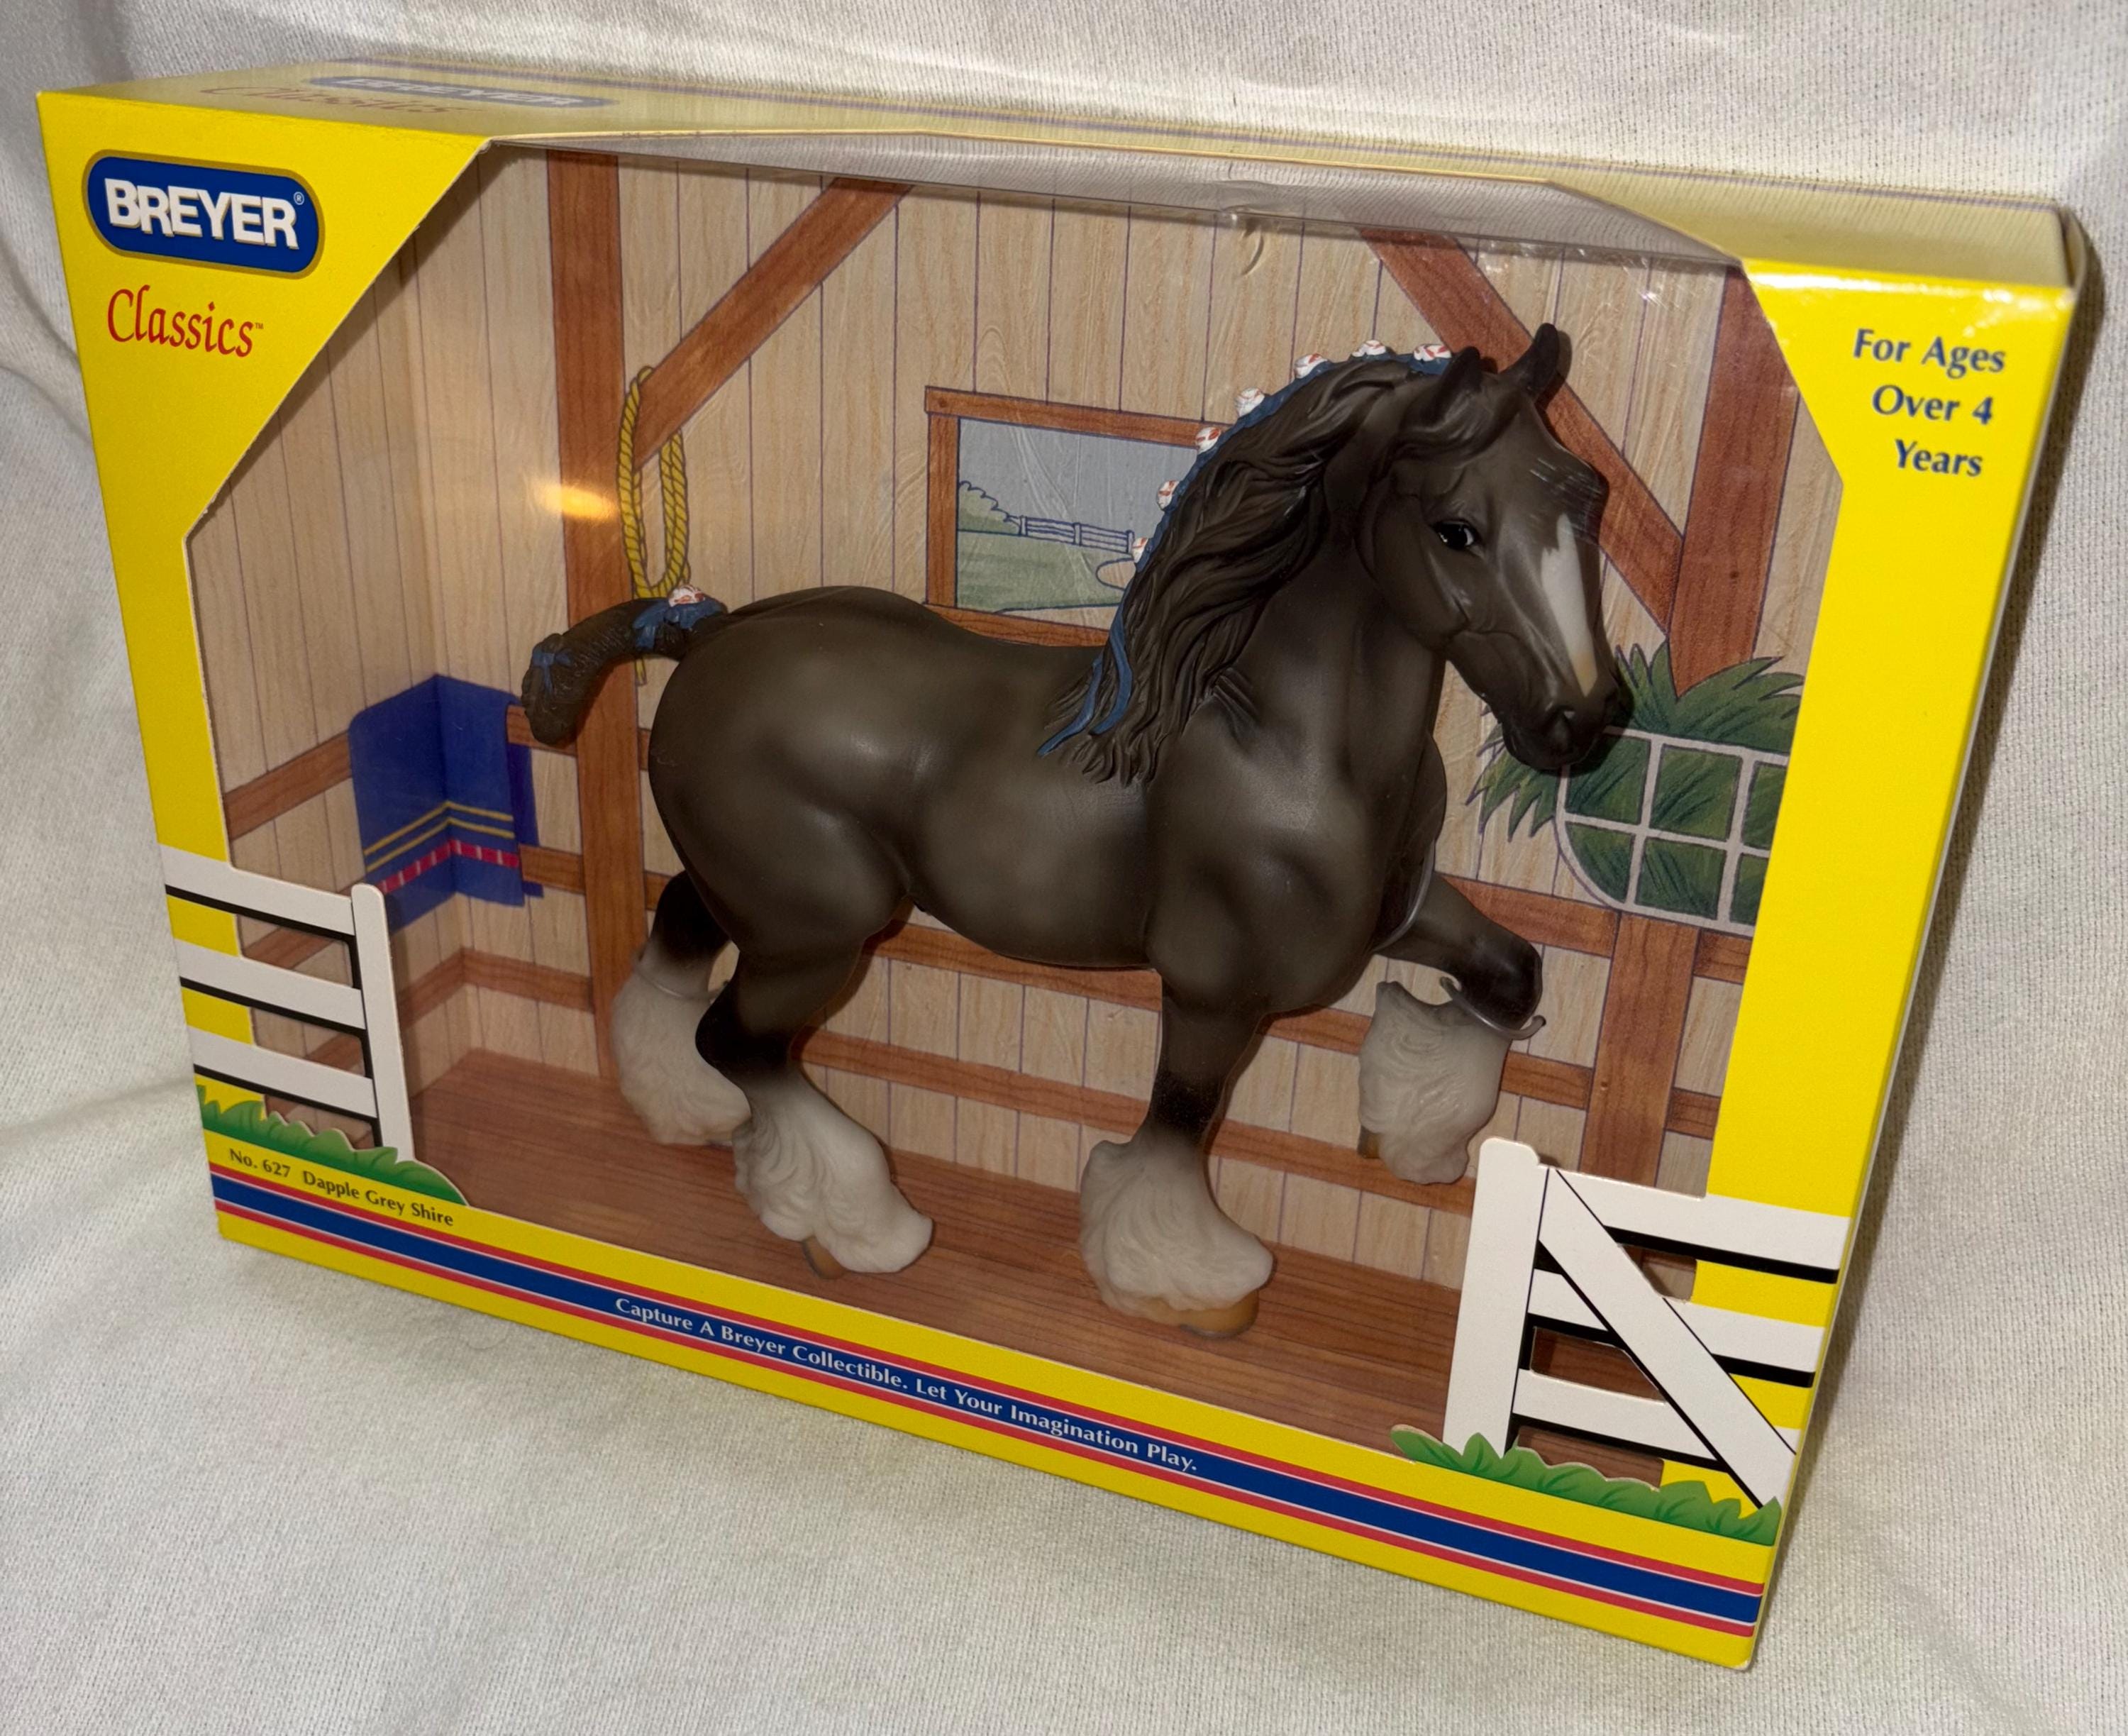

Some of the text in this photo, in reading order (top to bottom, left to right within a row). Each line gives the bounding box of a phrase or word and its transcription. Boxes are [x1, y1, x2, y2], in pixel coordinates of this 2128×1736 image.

[1853, 328, 2007, 380] For Ages
[1871, 384, 1993, 426] Over 4
[1895, 438, 1983, 477] Years
[229, 1148, 454, 1227] No. 627 Dapple Grey Shire
[615, 1297, 1198, 1472] Capture A Breyer Collectible. Let Your Imagination Play.
